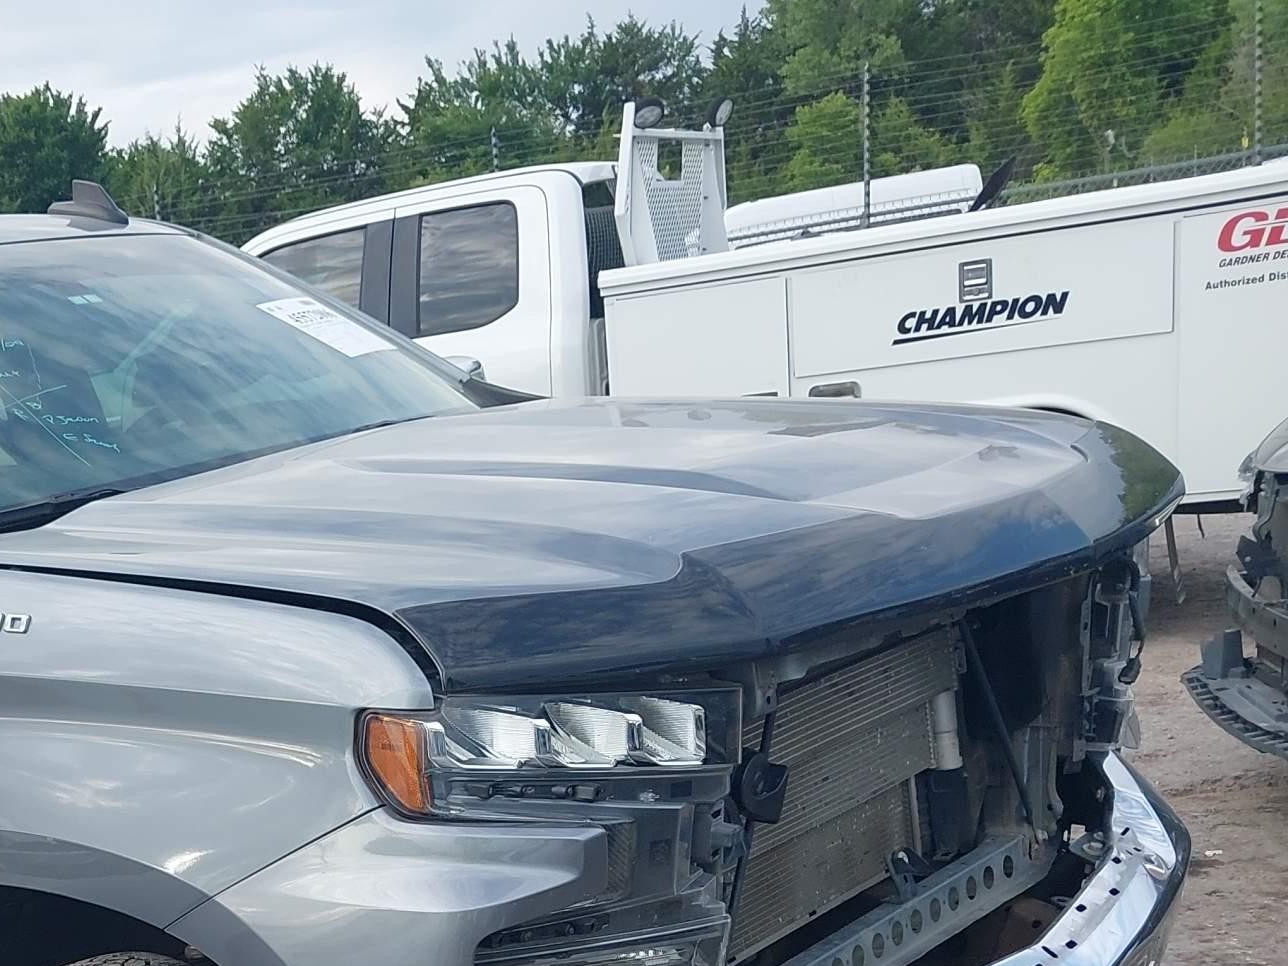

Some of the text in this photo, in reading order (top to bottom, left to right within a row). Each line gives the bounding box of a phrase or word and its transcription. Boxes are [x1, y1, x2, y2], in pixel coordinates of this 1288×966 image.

[1218, 249, 1288, 268] GARDNER DE
[1205, 271, 1288, 290] Authorized Dis
[897, 291, 1069, 335] CHAMPION
